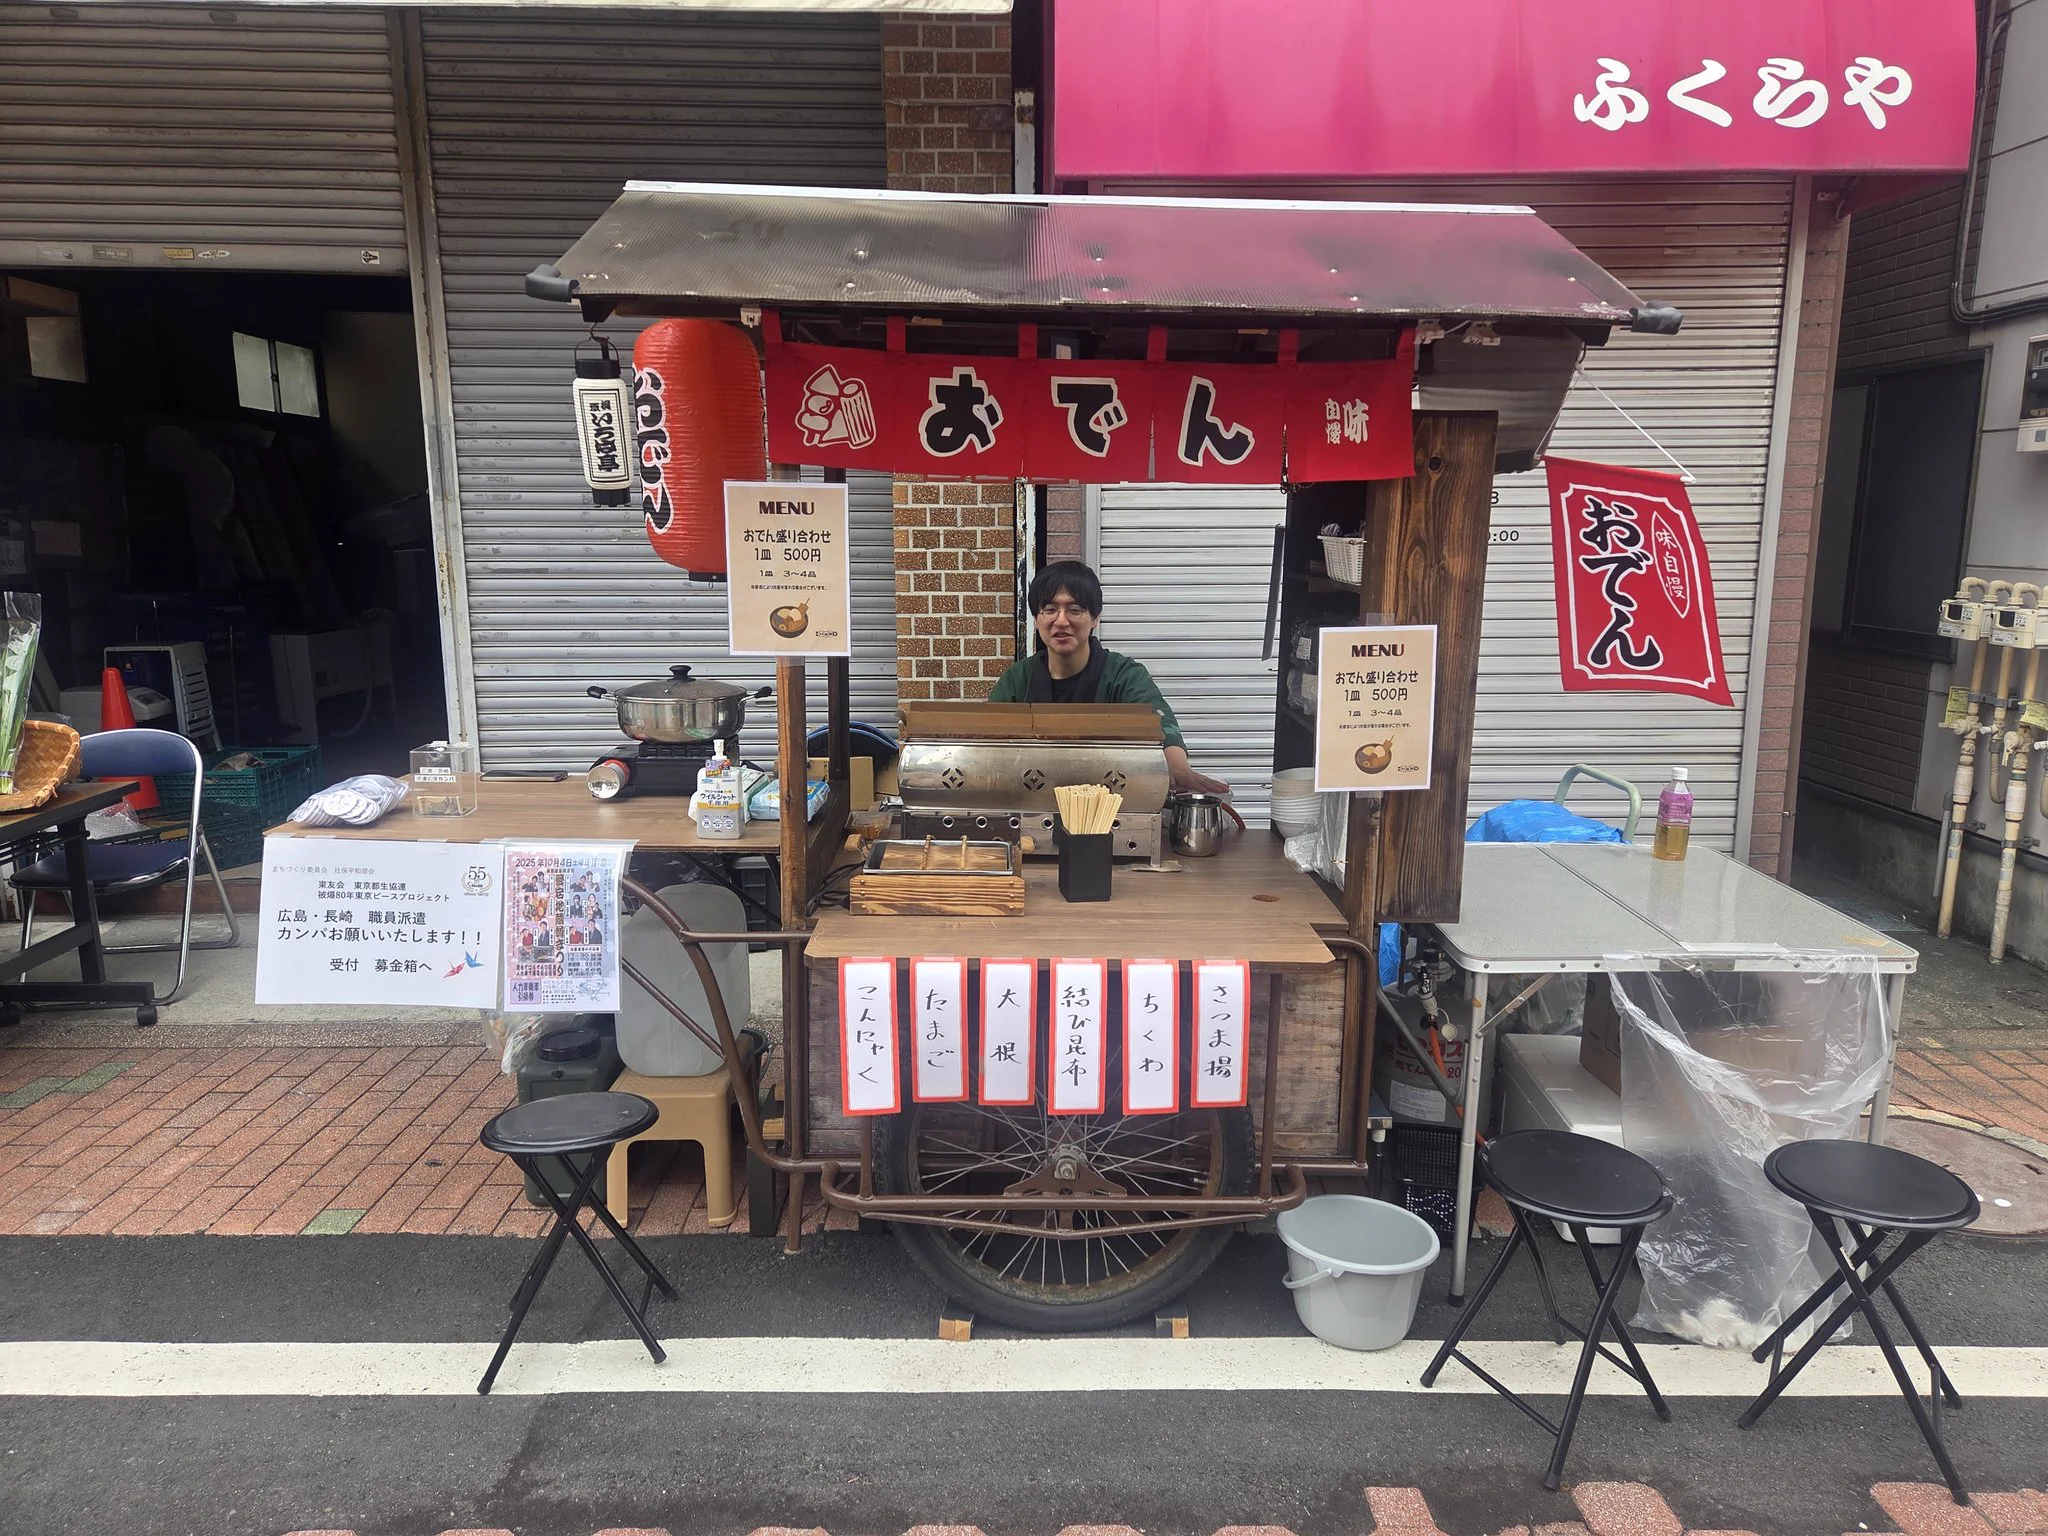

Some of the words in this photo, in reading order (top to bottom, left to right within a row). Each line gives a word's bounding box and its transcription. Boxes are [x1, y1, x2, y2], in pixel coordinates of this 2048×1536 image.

[1573, 56, 1912, 131] ふくらや
[919, 366, 1255, 467] おでん
[759, 501, 814, 515] MENU
[743, 528, 831, 543] おでん盛り合わせ
[754, 548, 771, 561] 1皿
[783, 548, 821, 562] 500円
[1655, 528, 1686, 599] 味自慢
[1578, 496, 1664, 669] おでん
[1351, 644, 1404, 658] MENU
[1335, 670, 1418, 685] おでん盛り合わせ
[1344, 689, 1360, 701] 1皿
[1372, 688, 1408, 701] 500円
[272, 866, 328, 874] まちづくり委員会
[468, 866, 486, 880] 55
[318, 880, 345, 889] 東友会
[354, 881, 407, 891] 東京都生協連
[277, 909, 353, 924] 広島・長崎
[368, 910, 427, 926] 職員派遣
[329, 957, 359, 973] 受付
[374, 958, 432, 973] 募金箱へ
[856, 984, 884, 1084] こんにゃく
[925, 987, 955, 1068] たまご
[989, 987, 1022, 1065] 大根
[1138, 992, 1164, 1073] ちくわ
[1203, 984, 1234, 1079] さつま揚
[1061, 985, 1091, 1087] 結び昆布
